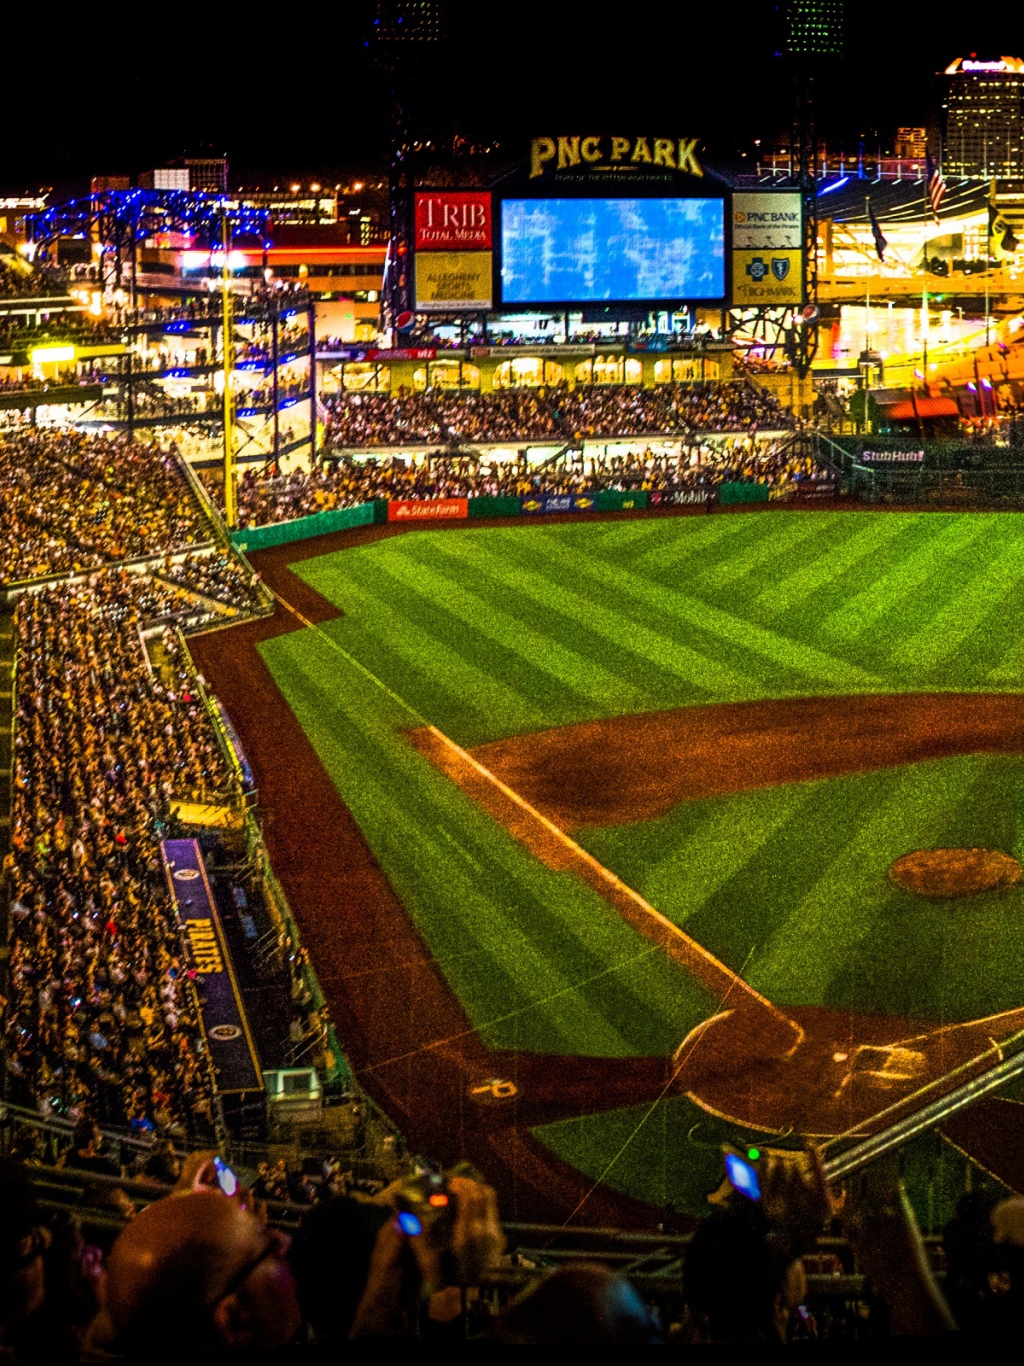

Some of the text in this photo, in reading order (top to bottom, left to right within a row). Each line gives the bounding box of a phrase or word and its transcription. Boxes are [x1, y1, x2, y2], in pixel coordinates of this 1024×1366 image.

[529, 135, 703, 179] PNC PARK
[419, 199, 486, 227] TRIB
[747, 213, 799, 222] PNC BANK
[862, 450, 924, 462] StubHub!
[185, 918, 224, 973] PIRATES
